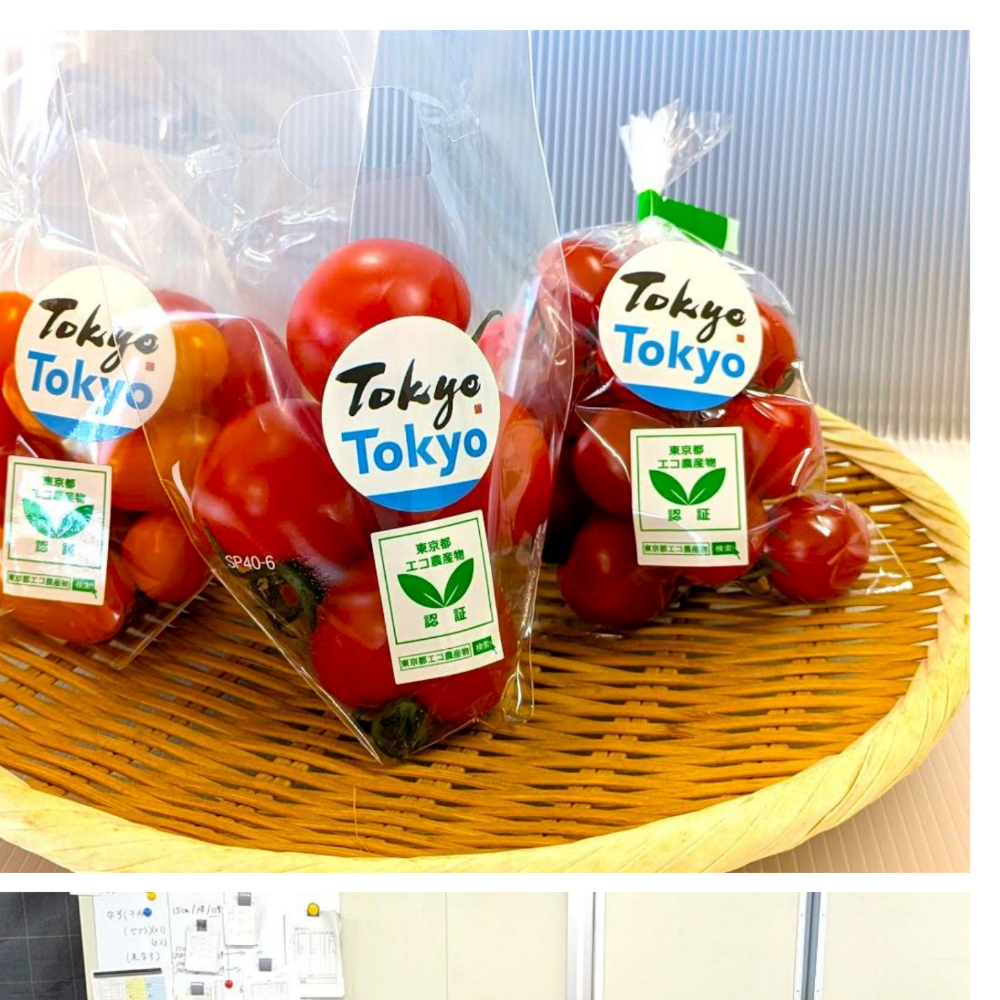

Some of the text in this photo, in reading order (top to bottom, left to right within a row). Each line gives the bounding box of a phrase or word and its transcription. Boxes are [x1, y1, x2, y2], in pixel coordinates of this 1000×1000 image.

[620, 271, 747, 343] Tokyo
[39, 297, 159, 374] Tokyo
[614, 324, 745, 384] Tokyo
[27, 352, 153, 417] Tokyo
[336, 359, 482, 430] Tokyo
[341, 423, 487, 477] Tokyo
[669, 444, 705, 456] 東京都
[657, 457, 716, 469] エコ農産物
[43, 475, 76, 489] 東京都
[415, 537, 452, 555] 東京都
[643, 543, 709, 555] 東京都エコ農産物
[225, 554, 276, 571] SP40-6
[405, 549, 466, 572] エコ農産物
[400, 645, 470, 668] 東京都エコ農産物
